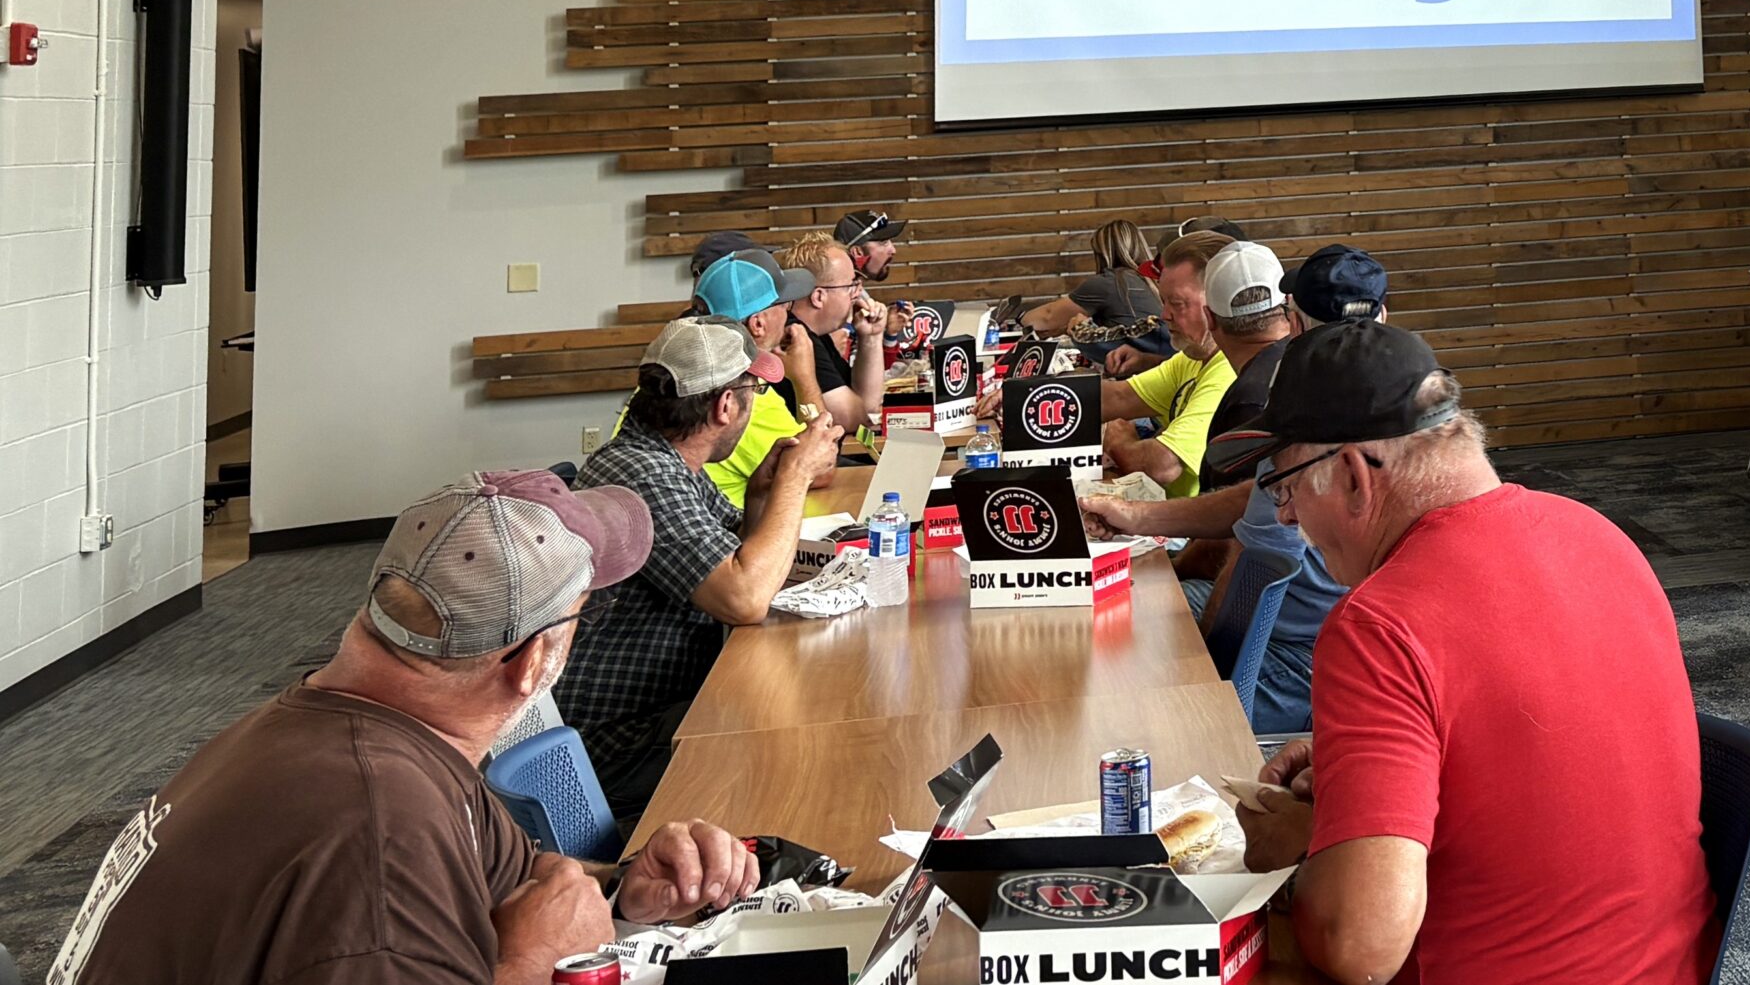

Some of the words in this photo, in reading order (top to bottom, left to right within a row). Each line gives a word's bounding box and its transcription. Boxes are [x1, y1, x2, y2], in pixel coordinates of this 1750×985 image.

[993, 524, 1025, 547] JOHN'S
[1027, 523, 1051, 547] JIMMY
[970, 573, 996, 589] BOX
[999, 571, 1093, 589] LUNCH
[1020, 899, 1084, 918] JOHN'S
[980, 954, 1030, 985] BOX
[1039, 947, 1220, 983] LUNCH
